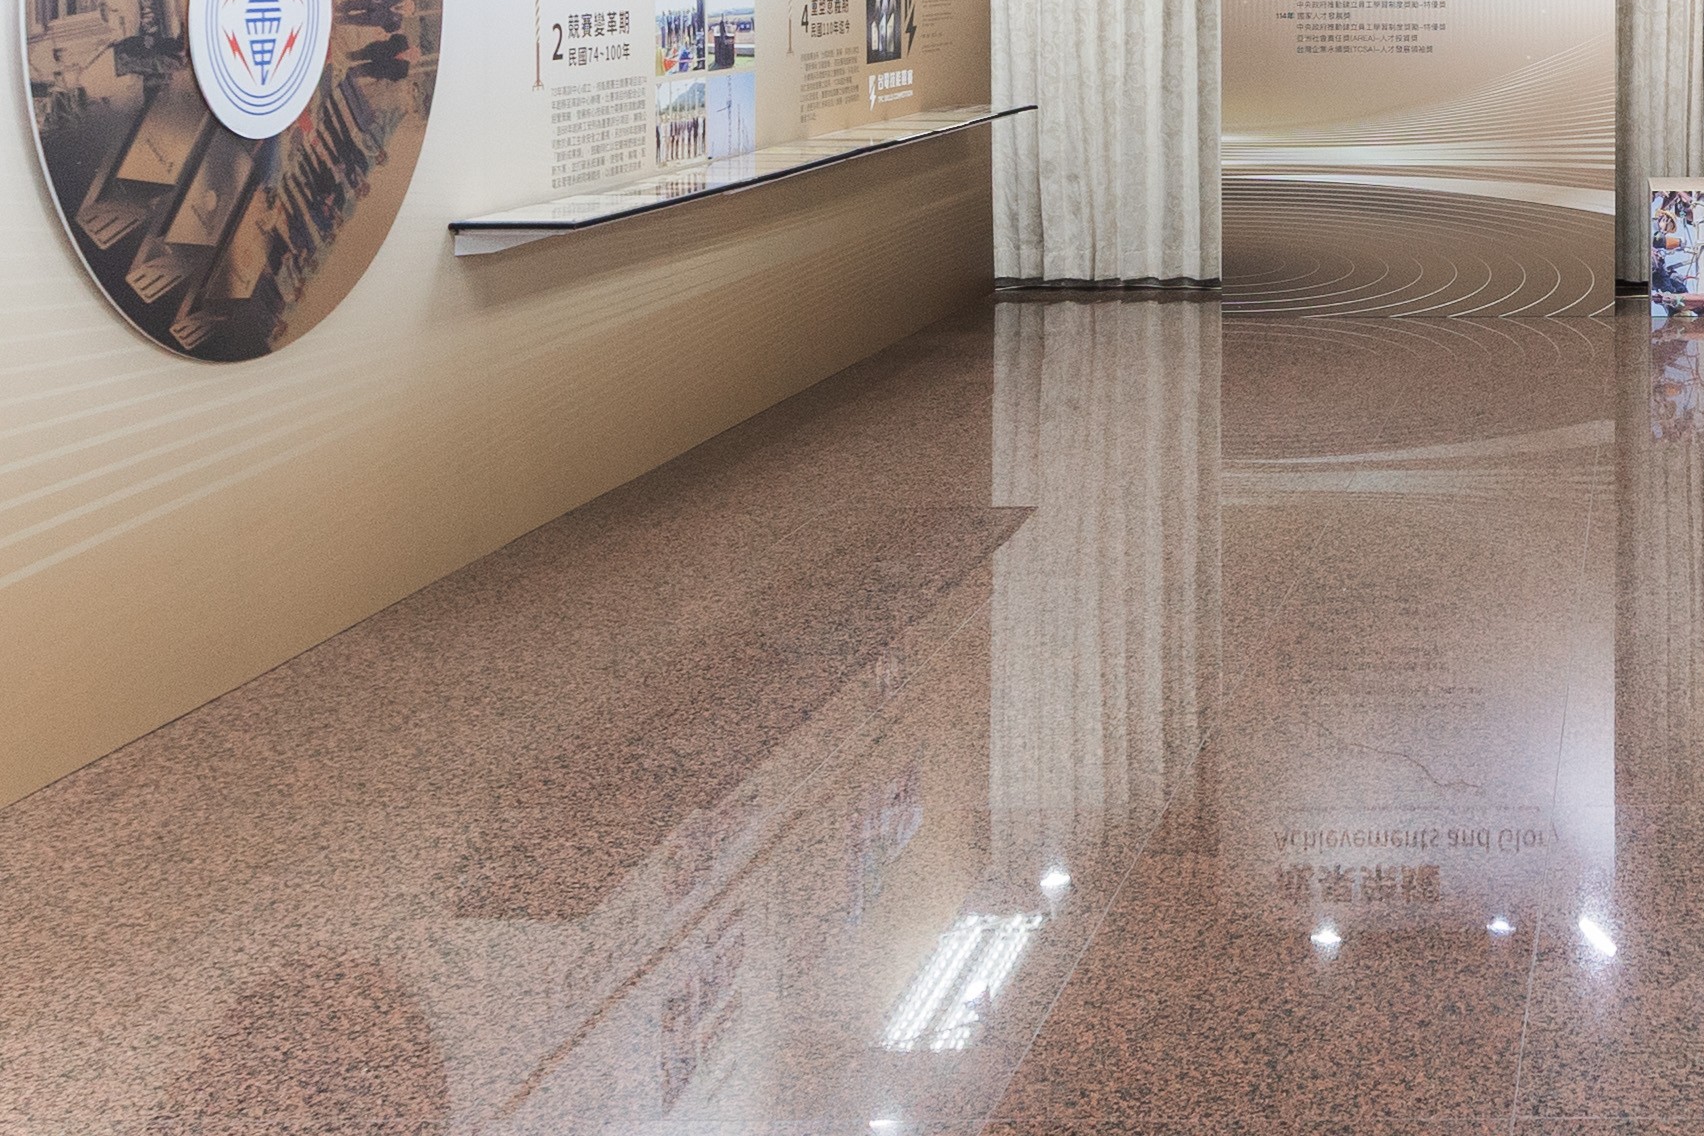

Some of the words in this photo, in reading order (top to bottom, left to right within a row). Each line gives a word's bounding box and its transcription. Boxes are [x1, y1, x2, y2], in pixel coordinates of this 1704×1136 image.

[552, 23, 563, 61] 2
[568, 11, 630, 40] 競賽變革期
[801, 4, 809, 33] 4
